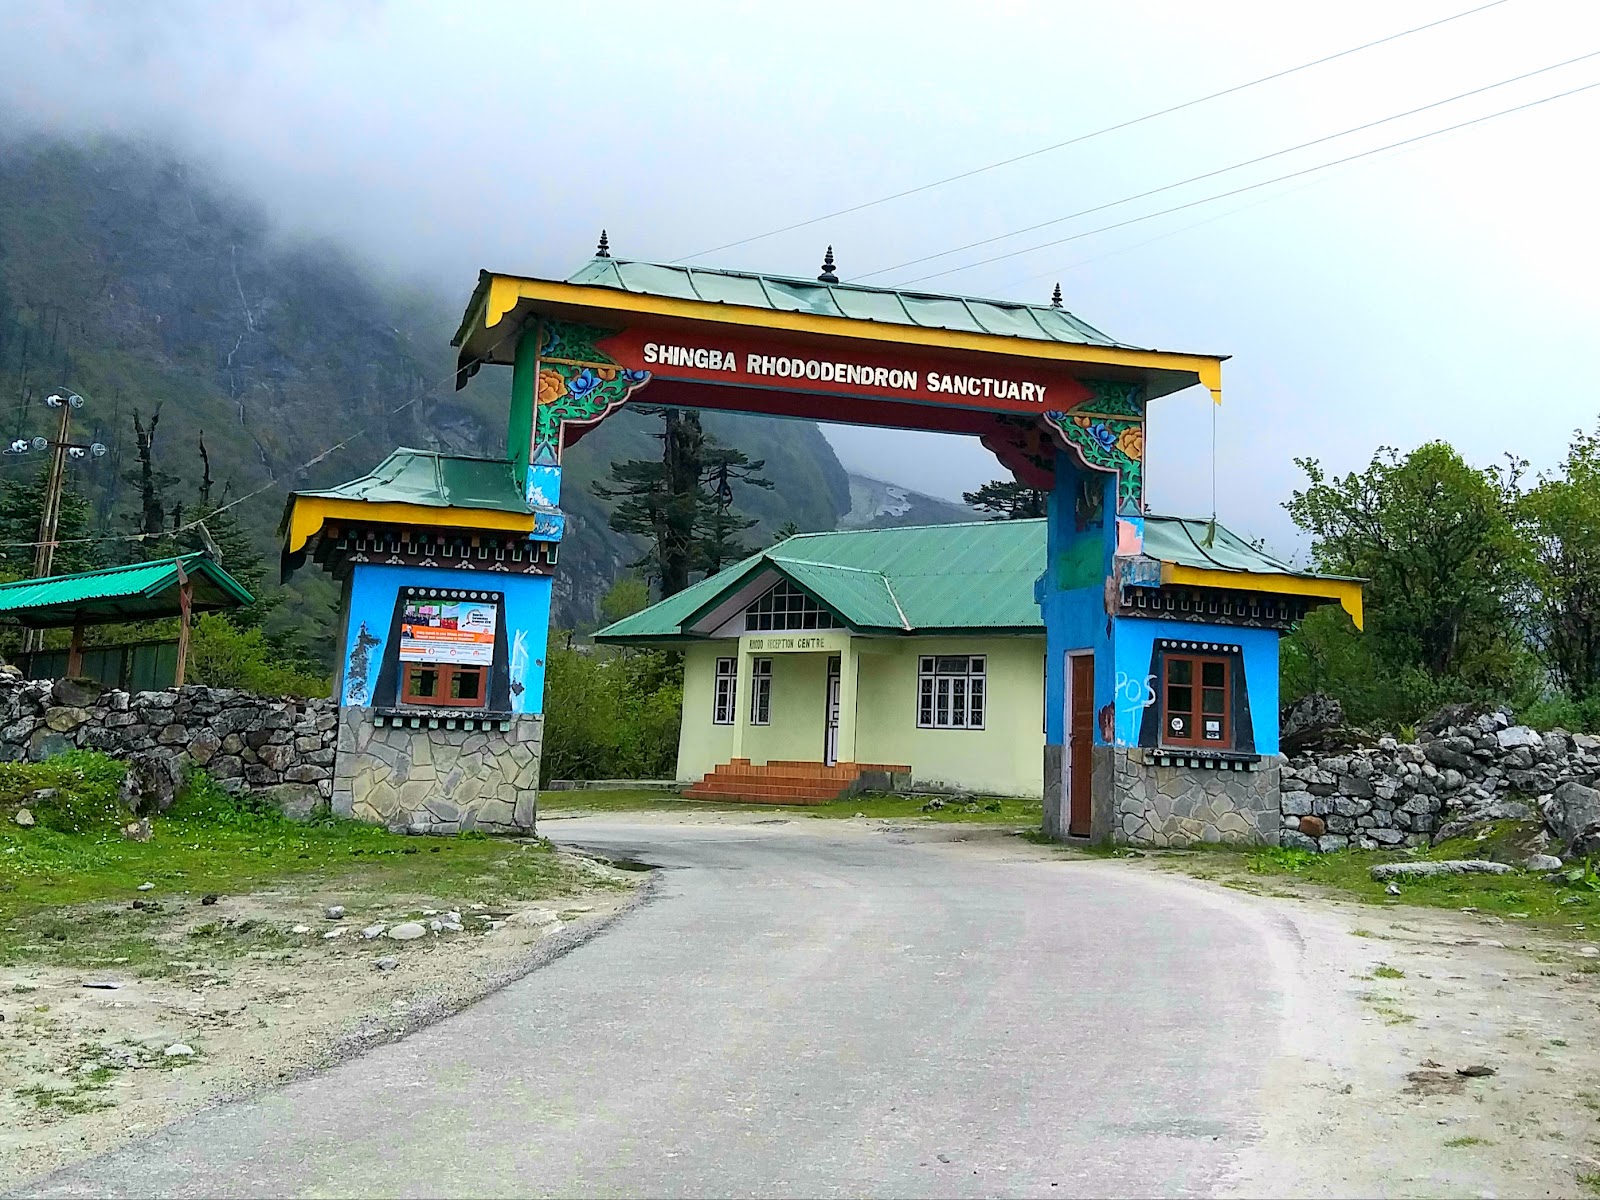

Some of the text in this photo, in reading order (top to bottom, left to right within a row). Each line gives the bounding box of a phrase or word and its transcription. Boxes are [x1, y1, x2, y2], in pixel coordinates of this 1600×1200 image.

[643, 343, 1047, 403] SHINGBA RHODODENDRON SANCTUARY
[797, 638, 825, 648] CENTRE
